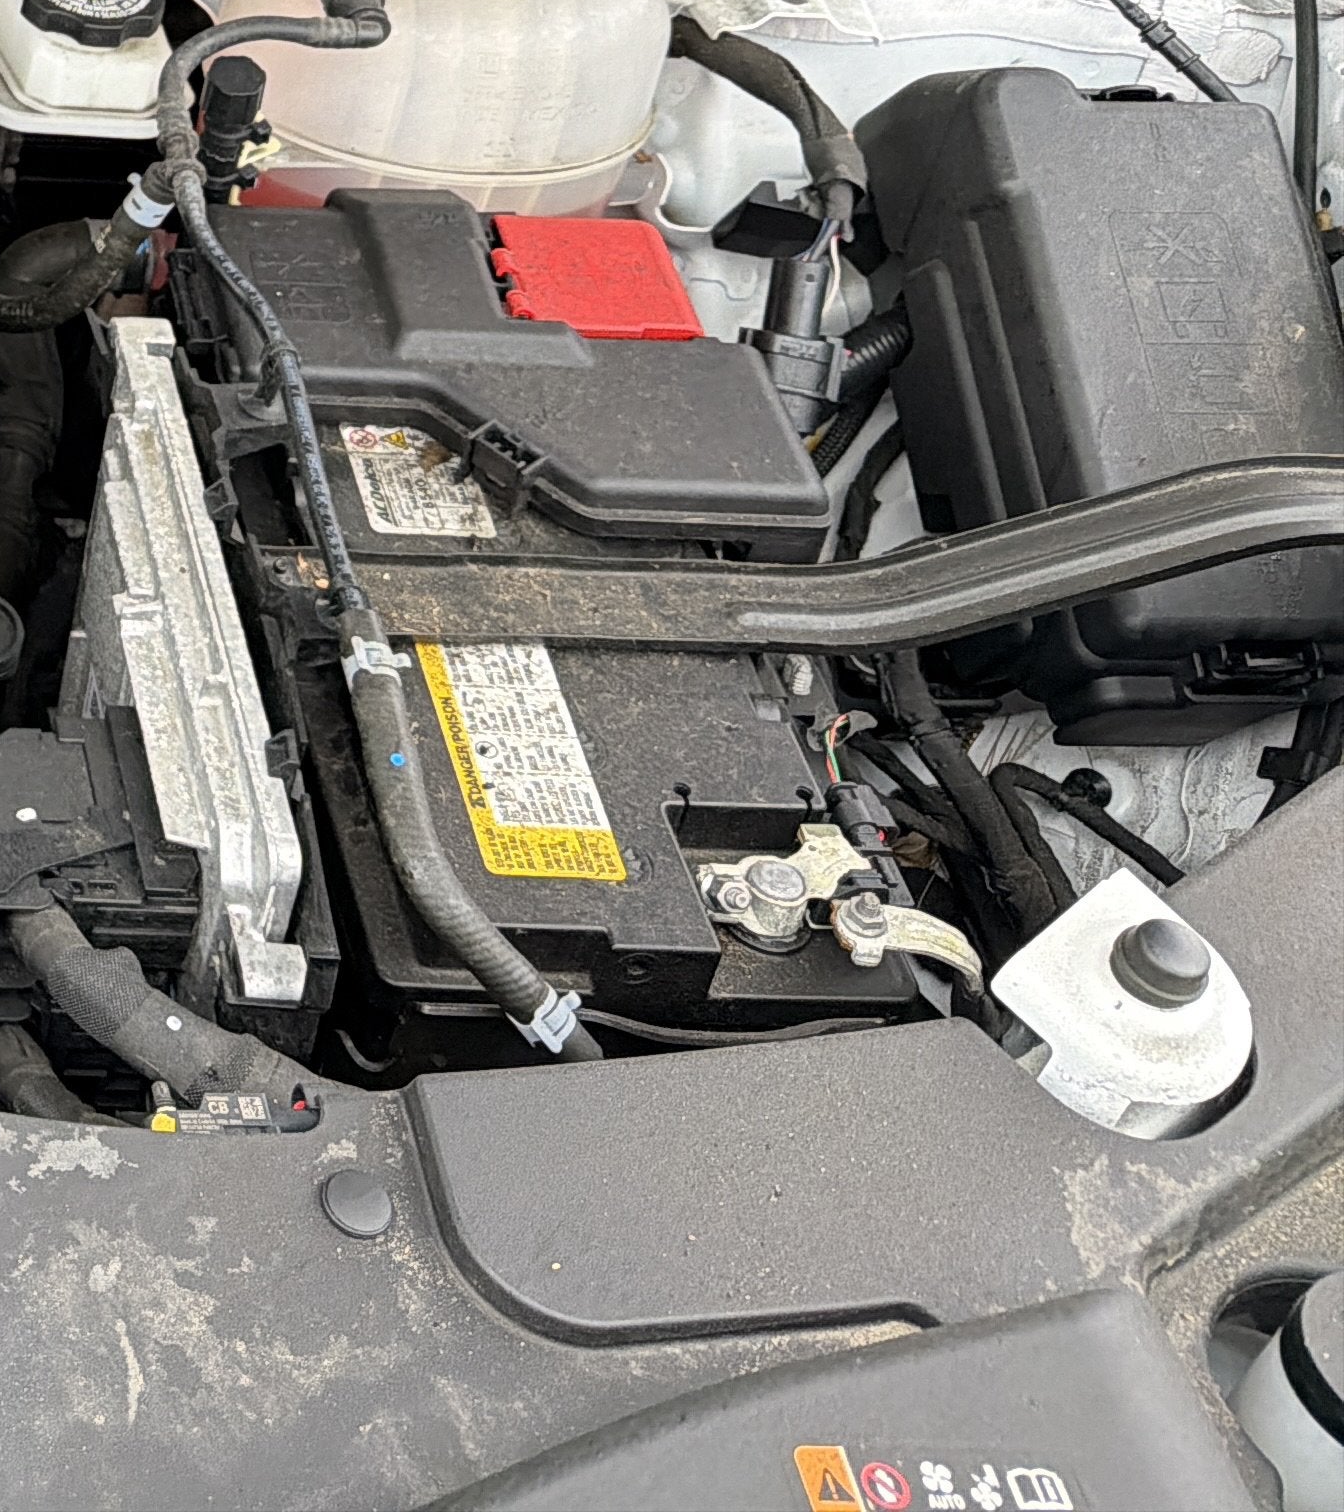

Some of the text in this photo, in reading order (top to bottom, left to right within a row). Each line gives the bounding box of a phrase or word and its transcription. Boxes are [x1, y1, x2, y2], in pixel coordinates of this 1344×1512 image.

[439, 695, 481, 797] DANGER/POISON
[207, 1101, 230, 1115] CB
[928, 1493, 966, 1510] AUTO
